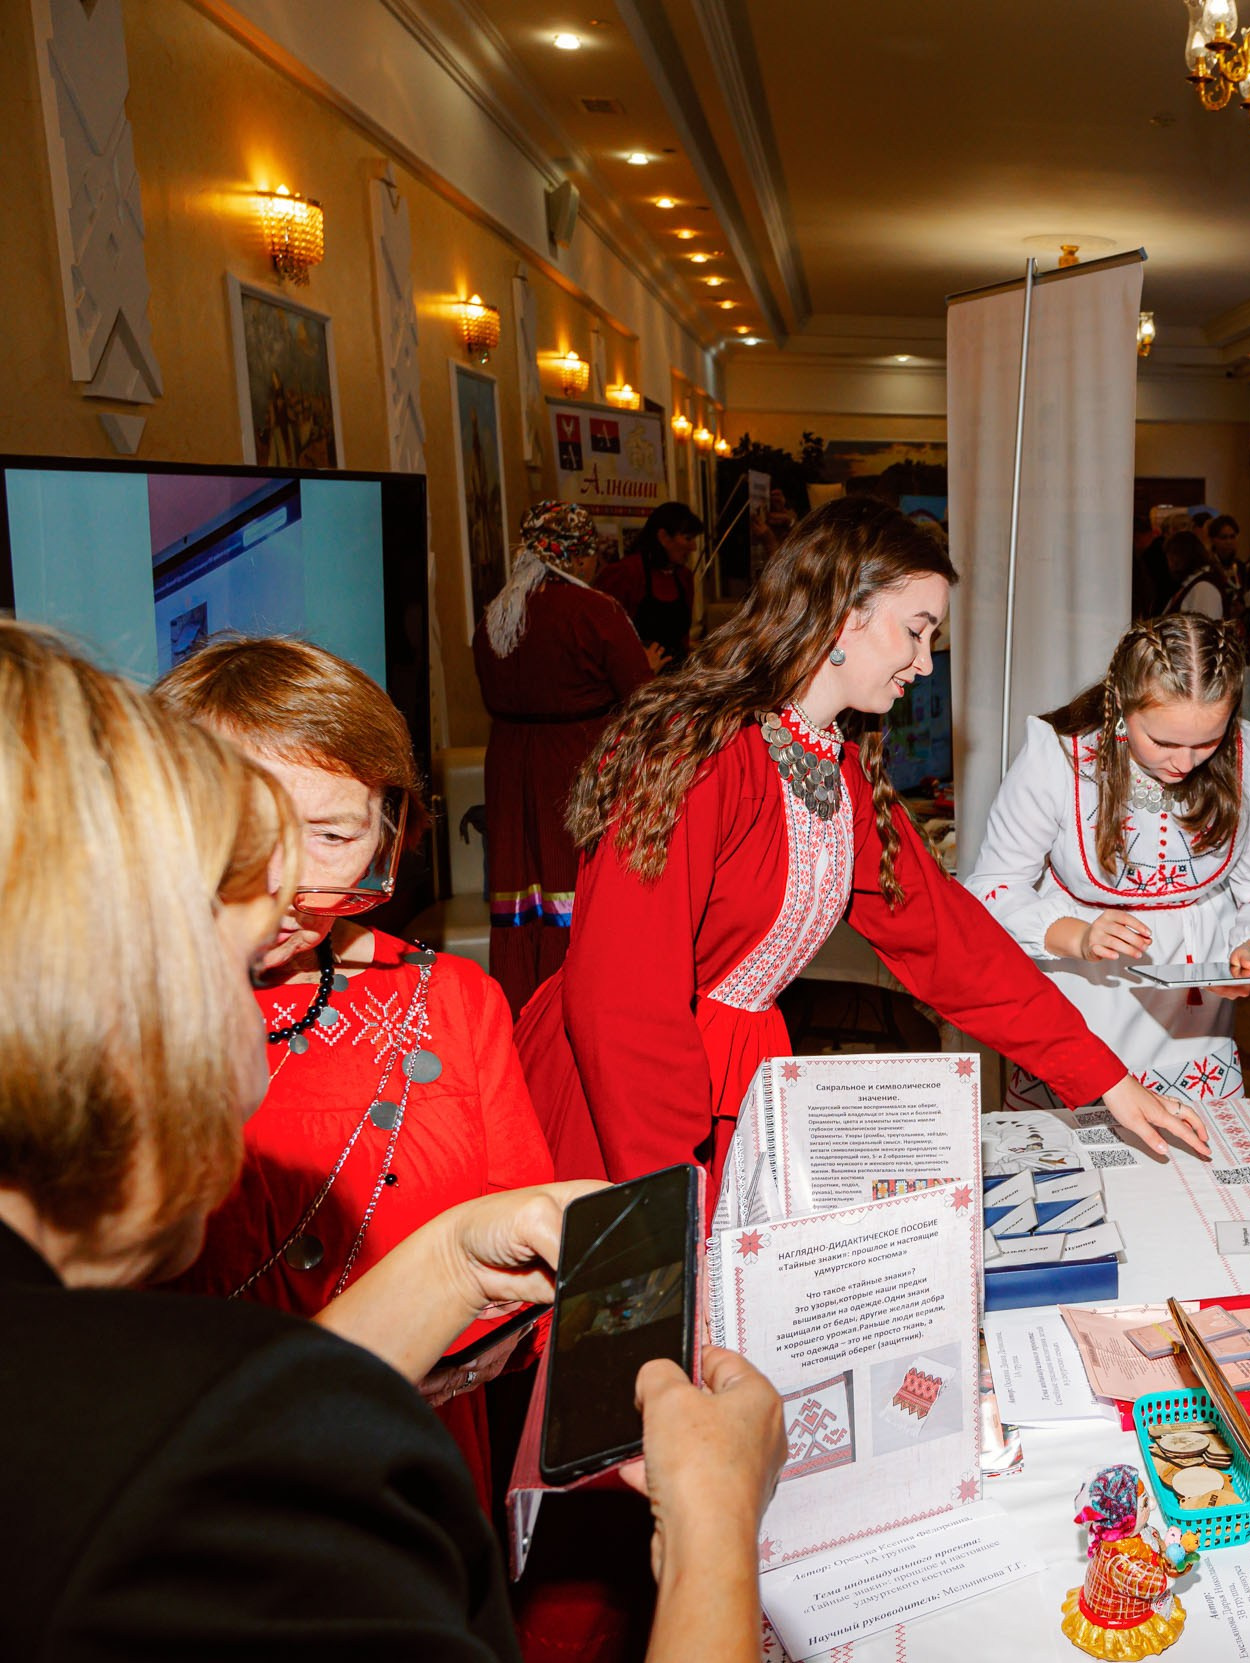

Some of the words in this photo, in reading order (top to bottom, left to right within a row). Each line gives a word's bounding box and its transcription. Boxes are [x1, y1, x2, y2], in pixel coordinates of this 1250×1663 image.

[816, 1084, 866, 1092] Сакральное
[778, 1228, 898, 1260] НАГЛЯДНО-ДИДАКТИЧЕСКОЕ
[901, 1219, 937, 1233] ПОСОБИЕ
[778, 1260, 816, 1271] «Тайные
[818, 1252, 849, 1263] знаки»:
[852, 1243, 888, 1256] прошлое
[814, 1259, 866, 1277] удмуртского
[868, 1250, 907, 1263] костюма»
[823, 1286, 846, 1296] такое
[848, 1278, 882, 1289] «тайные
[884, 1268, 916, 1282] знаки»?
[793, 1311, 836, 1325] вышивали
[908, 1288, 930, 1297] знаки
[795, 1306, 809, 1314] Это
[875, 1285, 896, 1294] наши
[899, 1277, 927, 1289] предки
[777, 1325, 821, 1340] защищали
[834, 1317, 858, 1326] беды,
[860, 1309, 887, 1321] другие
[889, 1301, 919, 1313] желали
[921, 1294, 945, 1306] добра
[784, 1336, 824, 1350] хорошего
[892, 1313, 913, 1323] люди
[916, 1306, 945, 1317] верили,
[801, 1350, 846, 1367] настоящий
[848, 1344, 876, 1355] оберег
[878, 1331, 924, 1350] (защитник).
[806, 1343, 839, 1355] одежда
[874, 1327, 901, 1338] просто
[903, 1322, 926, 1331] ткань,
[813, 1588, 841, 1600] Тема
[844, 1556, 932, 1590] индивидуального
[935, 1538, 980, 1558] проекта:
[809, 1624, 859, 1646] Научный
[862, 1594, 940, 1628] руководитель:
